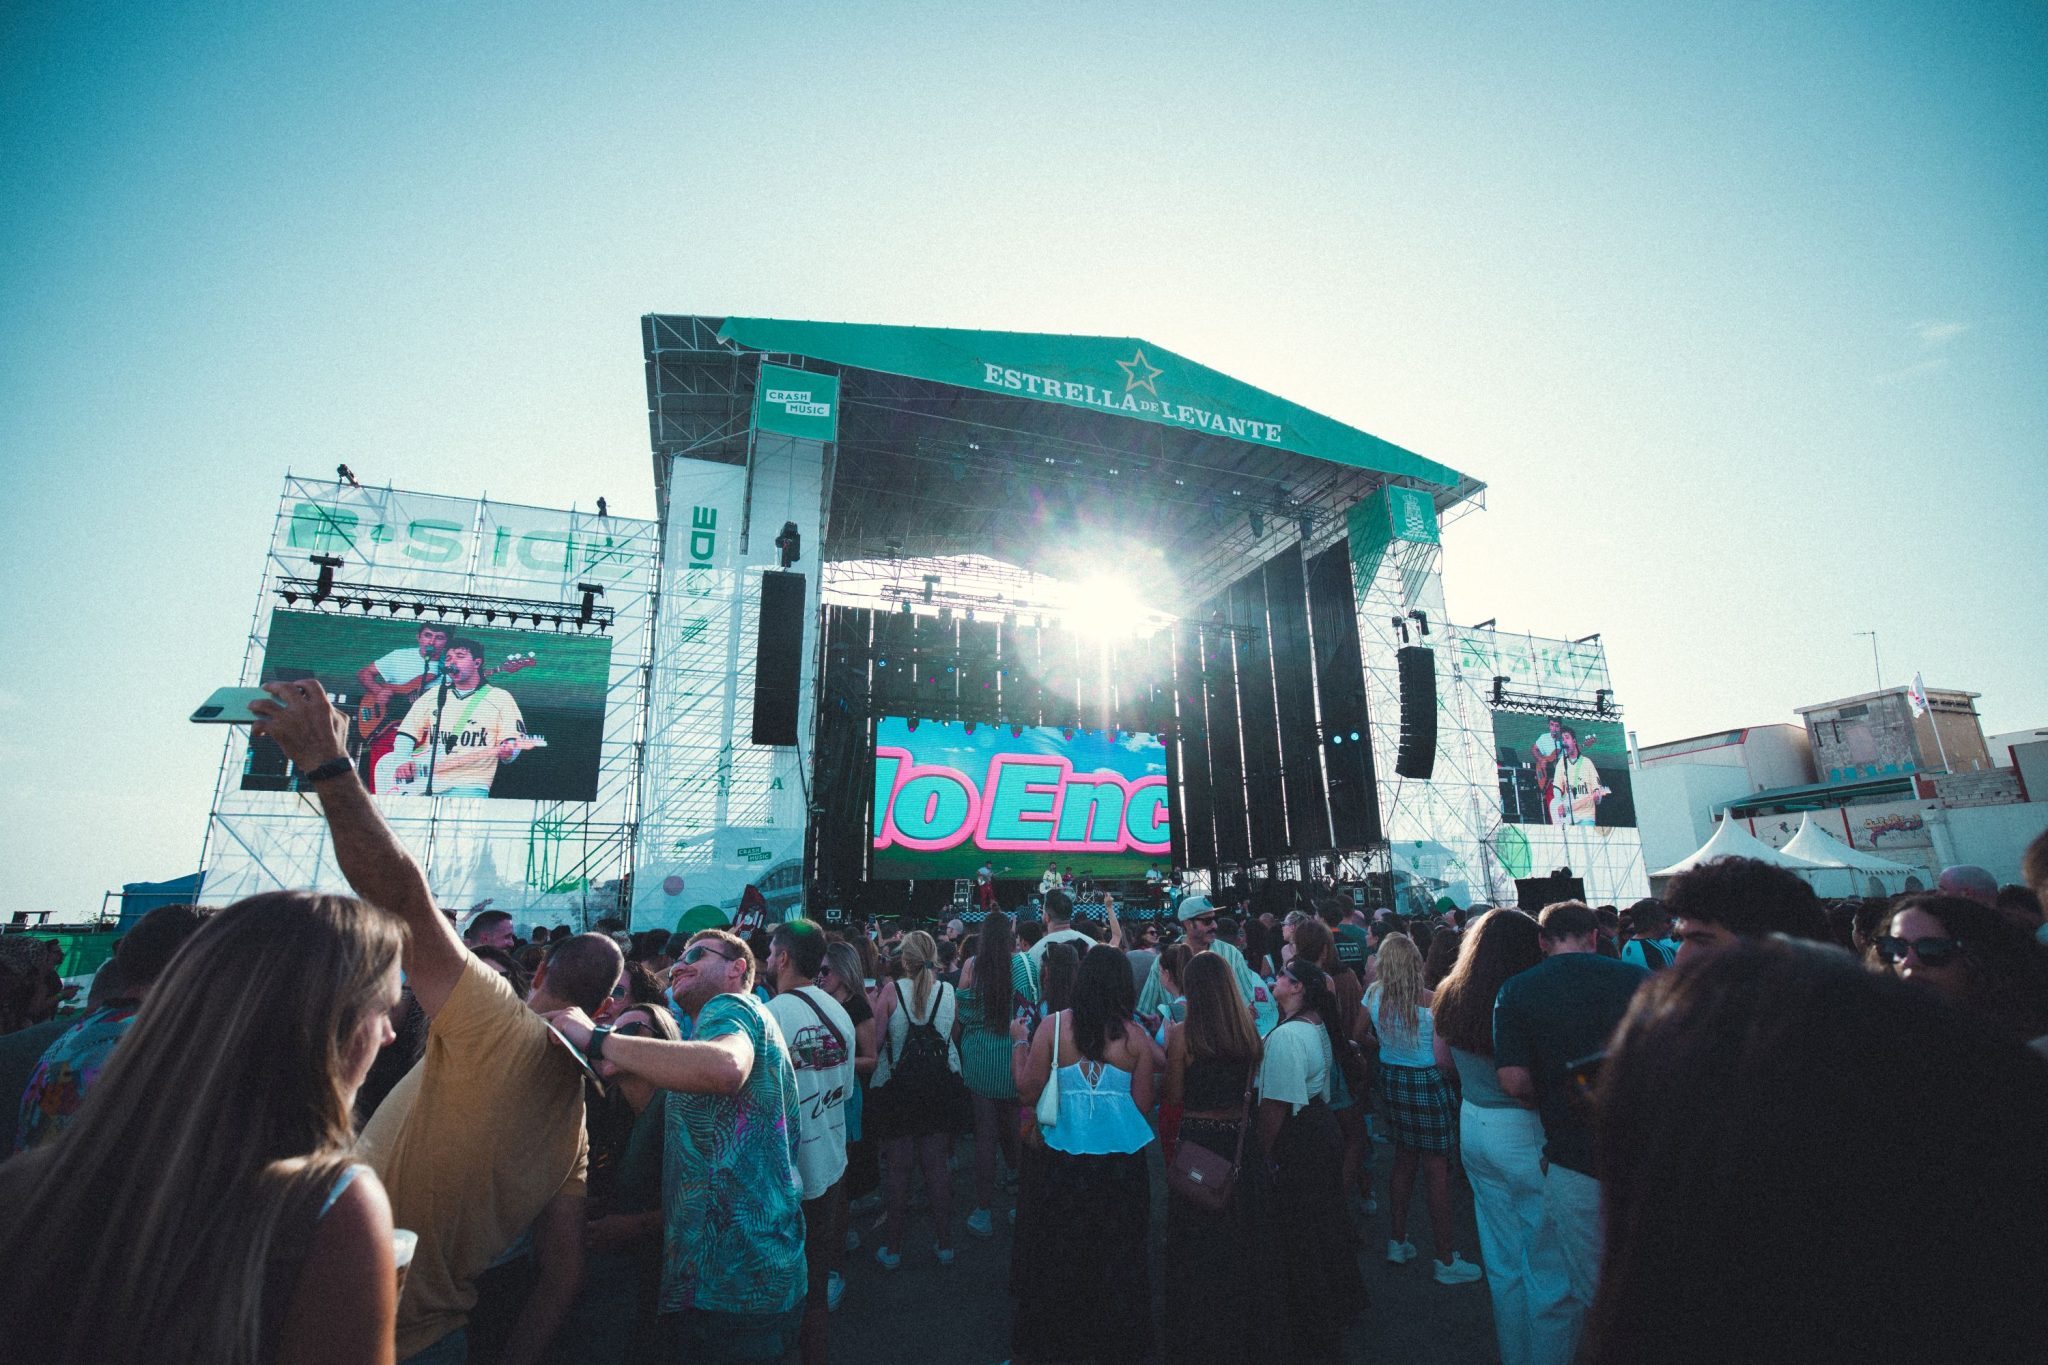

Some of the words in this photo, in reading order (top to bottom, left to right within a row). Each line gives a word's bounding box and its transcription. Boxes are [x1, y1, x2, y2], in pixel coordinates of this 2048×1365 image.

[768, 391, 808, 401] CRASH
[983, 363, 1140, 412] ESTRELLA
[1140, 399, 1160, 413] DE
[1160, 400, 1282, 443] LEVANTE
[790, 405, 825, 415] MUSIC
[452, 727, 488, 747] ork
[739, 847, 761, 855] CRASH
[749, 853, 769, 861] MUSIC
